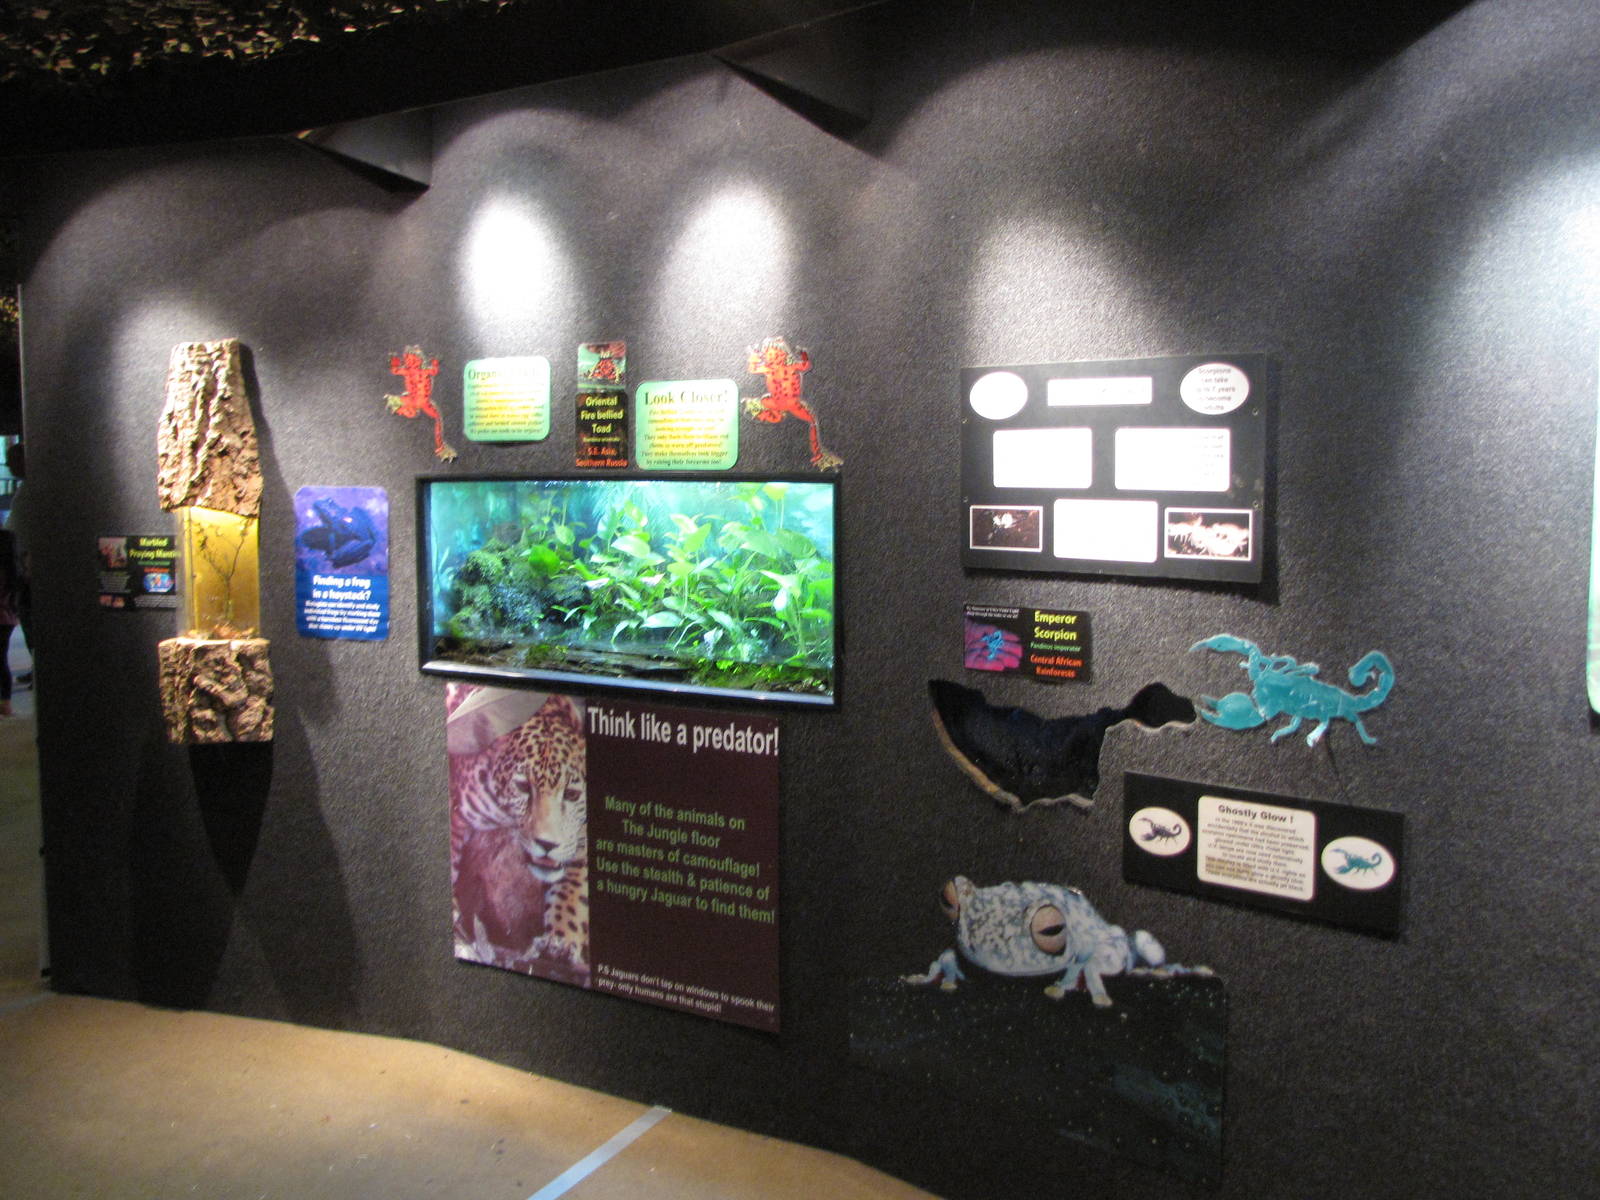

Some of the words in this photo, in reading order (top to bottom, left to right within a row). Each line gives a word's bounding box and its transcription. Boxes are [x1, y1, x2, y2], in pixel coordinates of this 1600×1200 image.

[586, 396, 618, 407] Oriental
[645, 391, 676, 406] Look
[581, 411, 596, 420] Fire
[597, 409, 624, 420] bellied
[592, 423, 611, 434] Toad
[313, 575, 344, 589] Finding
[352, 576, 371, 589] frog
[329, 589, 371, 601] haystack?
[1034, 610, 1077, 625] Emperor
[1034, 626, 1077, 641] Scorpion
[1030, 653, 1055, 665] Central
[1055, 655, 1083, 667] African
[588, 706, 636, 739] Think
[641, 712, 672, 743] like
[677, 722, 687, 746] a
[693, 722, 779, 756] predator!
[605, 796, 636, 816] Many
[639, 801, 653, 816] of
[655, 803, 674, 819] the
[677, 808, 725, 828] animals
[729, 818, 746, 831] on
[1218, 805, 1257, 820] Ghostly
[1260, 811, 1287, 823] Glow
[622, 819, 644, 836] The
[647, 824, 688, 846] Jungle
[692, 830, 721, 849] floor
[596, 839, 614, 851] are
[617, 841, 665, 861] masters
[668, 850, 681, 863] of
[683, 852, 760, 879] camouflage!
[597, 856, 619, 873] Use
[622, 860, 640, 877] the
[643, 867, 684, 886] stealth
[687, 872, 697, 888] &
[700, 876, 754, 899] patience
[757, 886, 771, 900] of
[596, 880, 603, 891] a
[607, 879, 648, 902] hungry
[651, 887, 692, 907] Jaguar
[696, 895, 708, 911] to
[712, 898, 736, 917] find
[739, 904, 775, 924] them!
[611, 967, 639, 981] Jaguars
[641, 974, 659, 985] don't
[661, 979, 673, 991] tap
[674, 983, 684, 992] on
[686, 984, 719, 999] windows
[721, 992, 729, 1002] to
[757, 999, 776, 1013] their
[618, 983, 633, 995] only
[635, 986, 664, 1000] humans
[666, 994, 677, 1003] are
[679, 995, 694, 1007] that
[695, 1000, 722, 1014] stupid!
